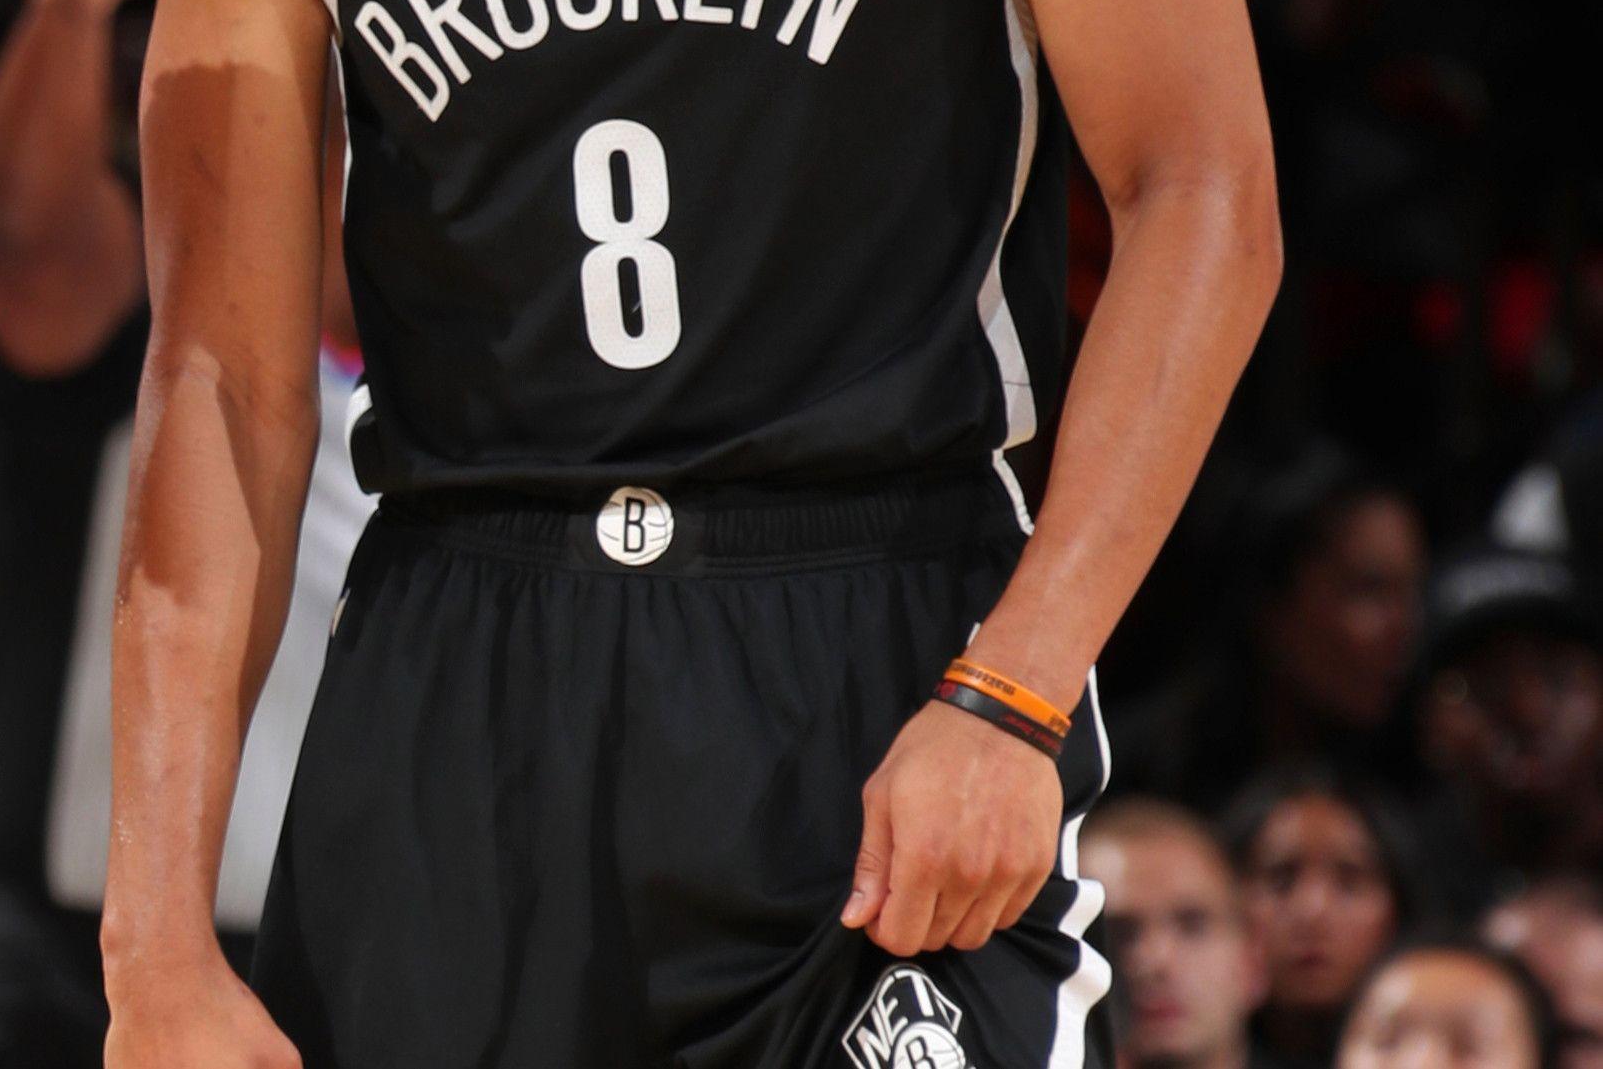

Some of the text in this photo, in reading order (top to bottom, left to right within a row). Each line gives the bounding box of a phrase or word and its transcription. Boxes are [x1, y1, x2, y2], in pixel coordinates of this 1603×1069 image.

[572, 118, 683, 370] 8
[623, 496, 646, 553] B
[856, 968, 951, 1069] NET
